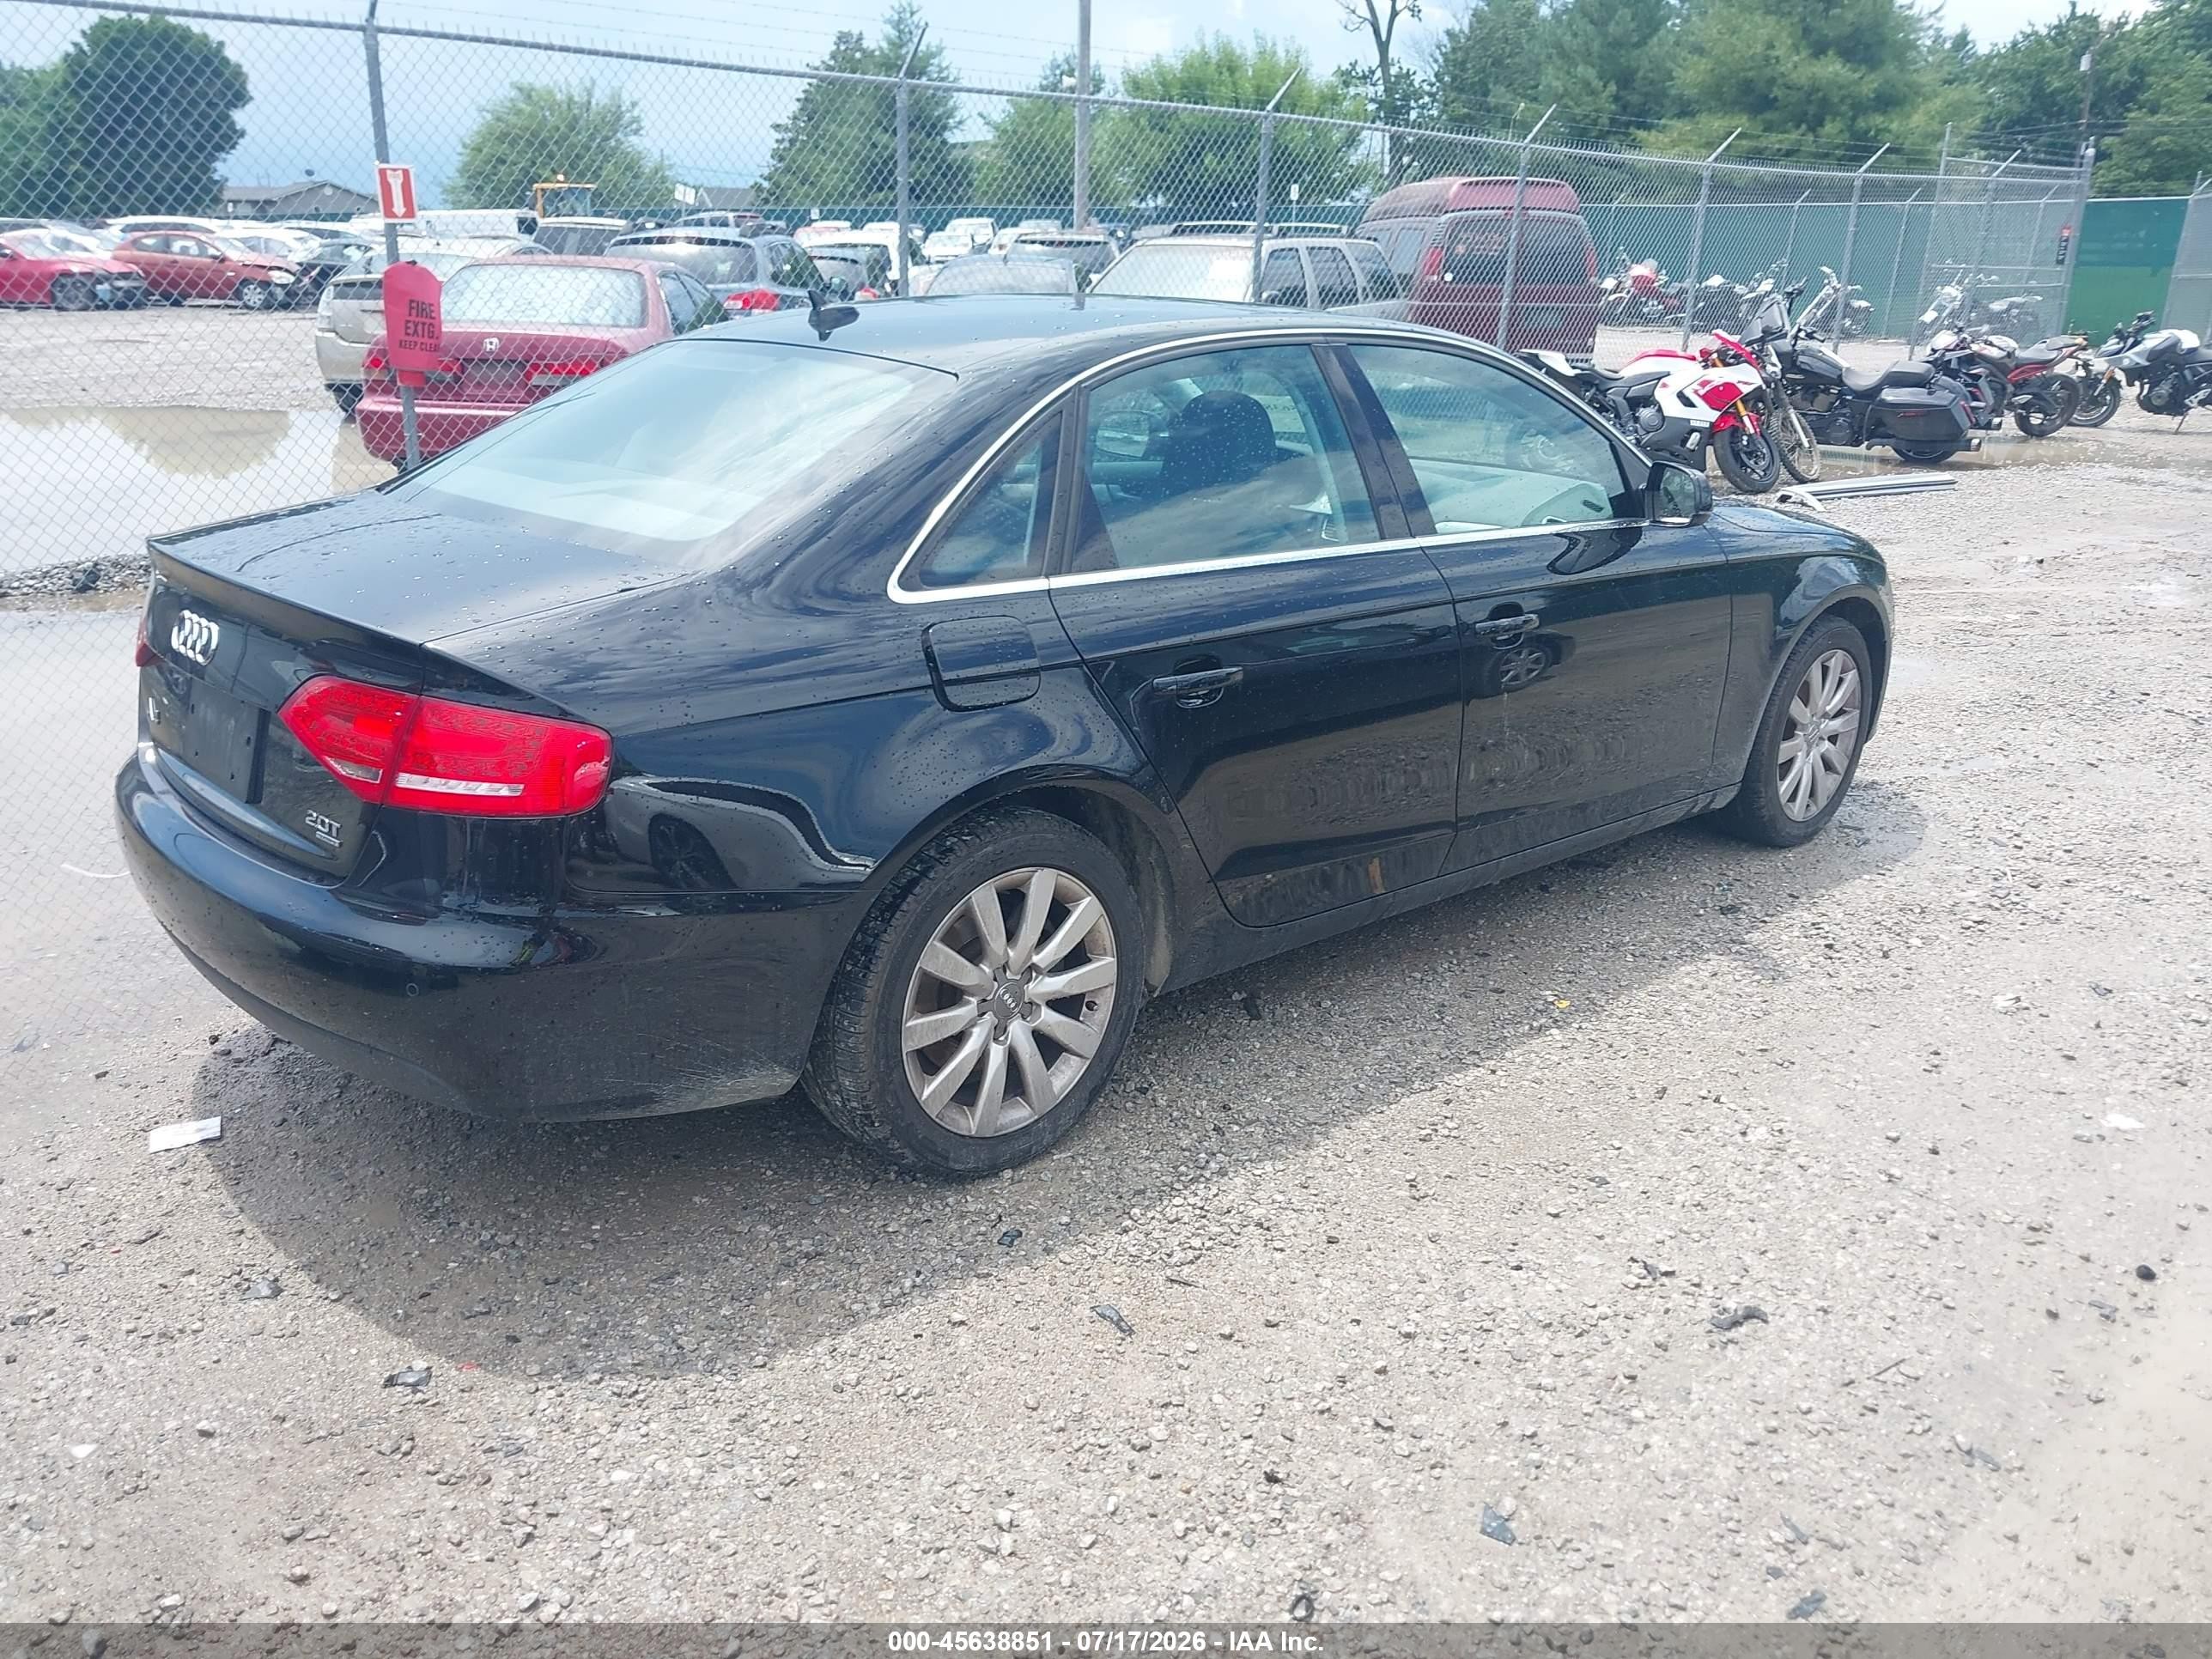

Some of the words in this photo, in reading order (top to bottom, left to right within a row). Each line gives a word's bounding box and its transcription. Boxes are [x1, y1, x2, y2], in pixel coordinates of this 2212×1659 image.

[408, 299, 436, 320] FIRE
[404, 319, 439, 340] EXTG.
[398, 339, 418, 350] KEEP
